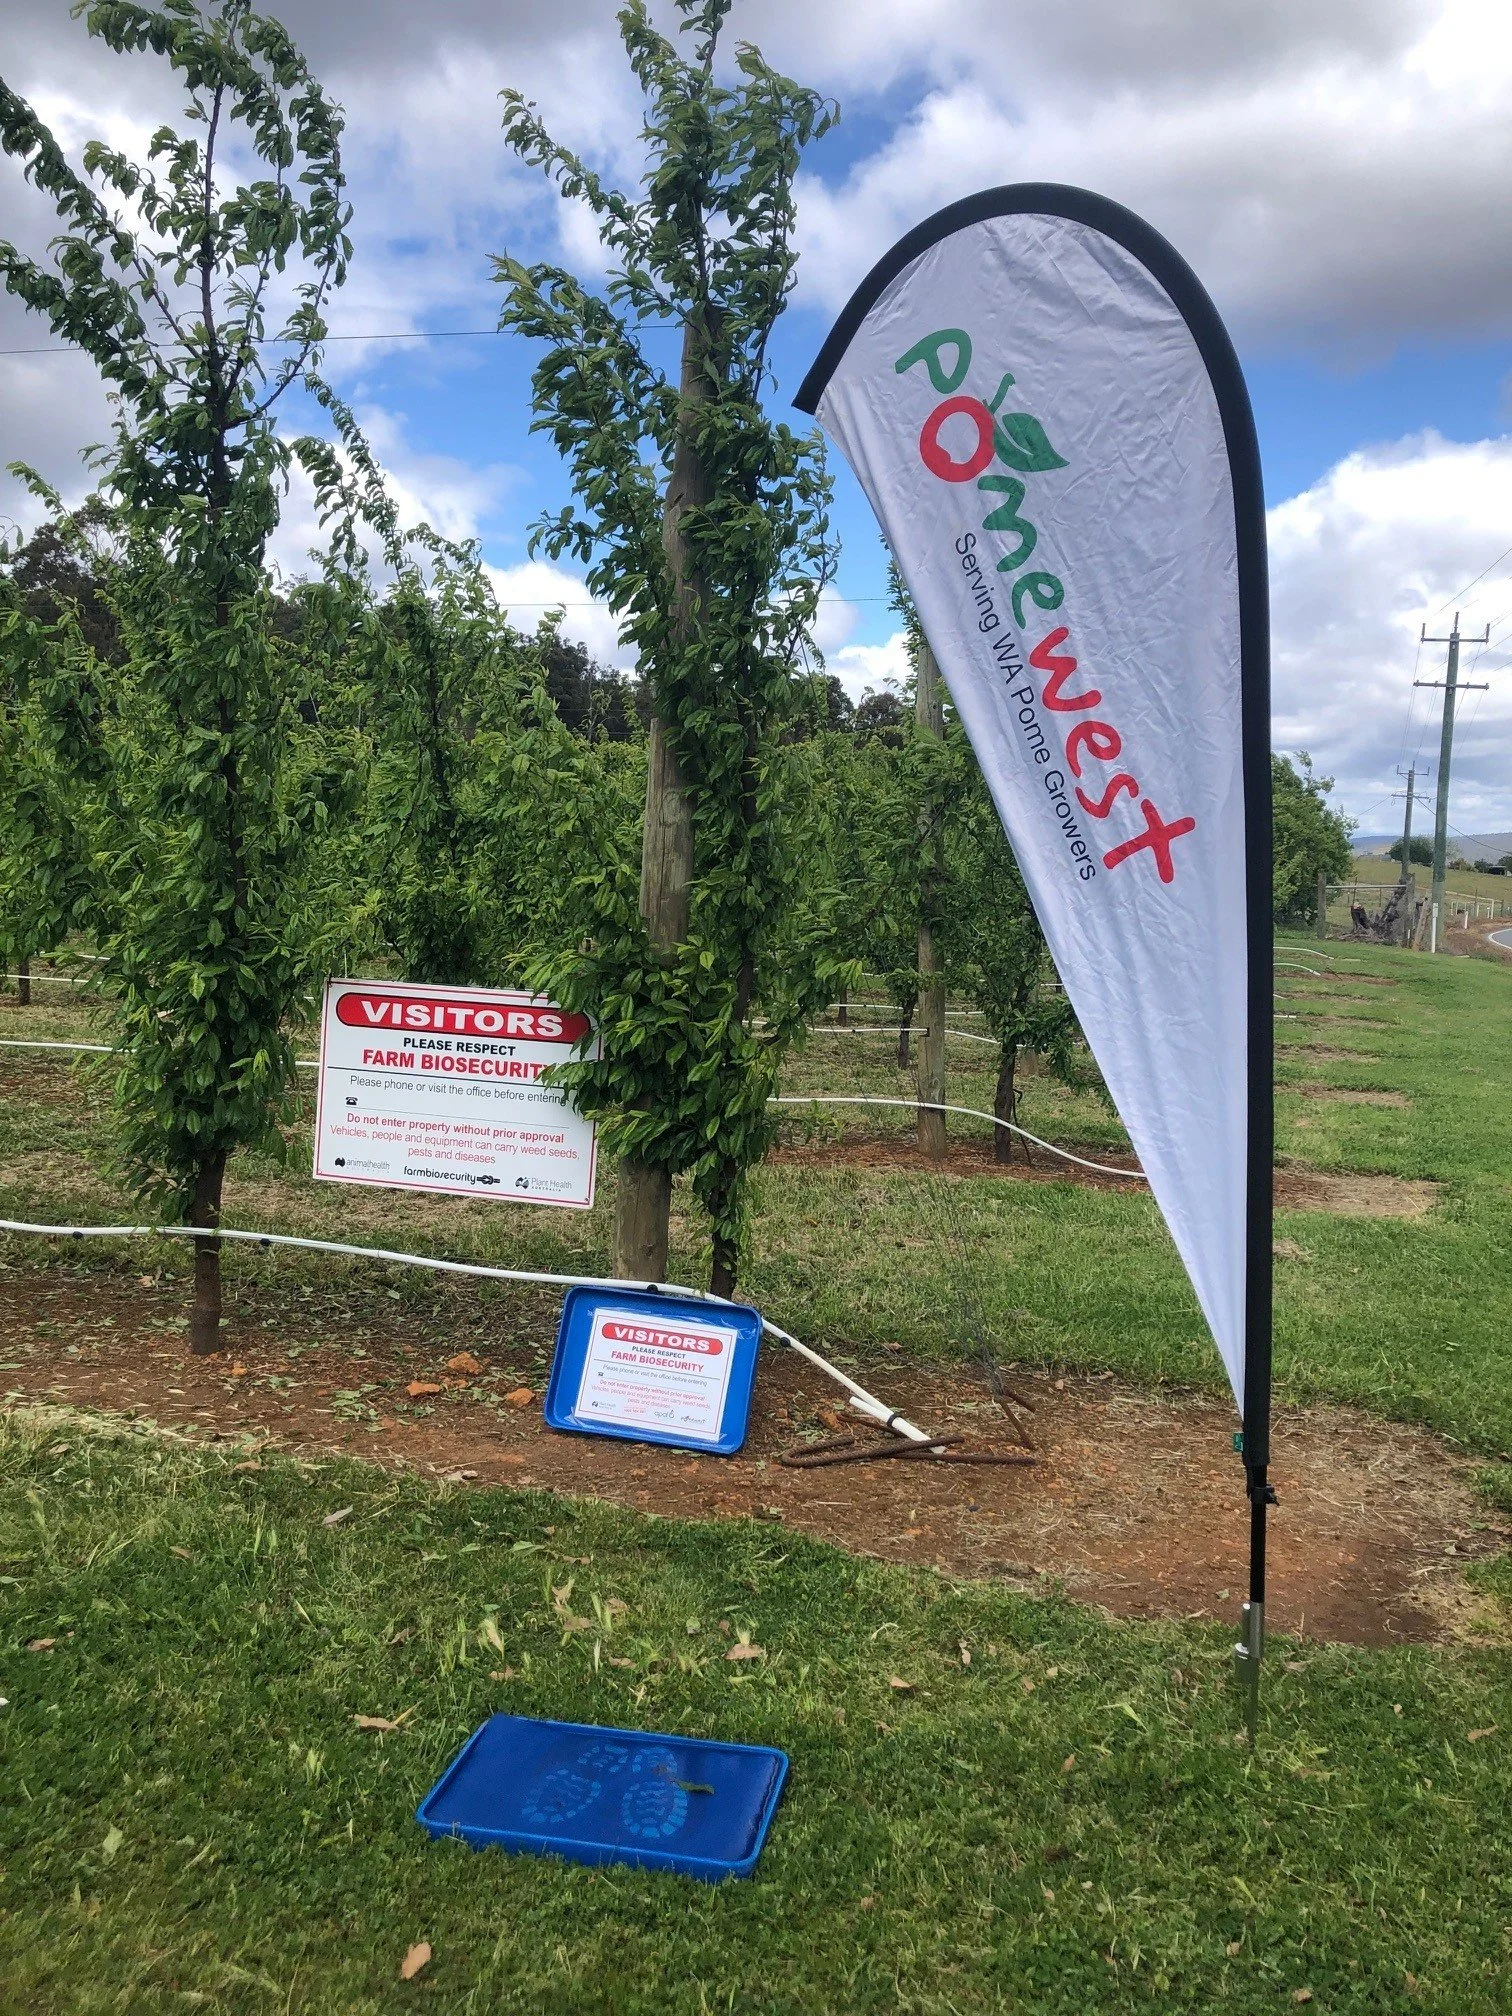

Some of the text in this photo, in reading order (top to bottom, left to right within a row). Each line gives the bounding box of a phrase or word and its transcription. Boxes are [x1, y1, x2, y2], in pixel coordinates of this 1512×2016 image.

[956, 532, 1096, 882] Serving WA Pome Growers
[361, 1001, 563, 1037] VISITORS
[403, 1037, 516, 1056] PLEASE RESPECT
[362, 1049, 549, 1079] FARM BIOSECURIT
[350, 1075, 381, 1087] Please
[384, 1079, 413, 1090] phone
[428, 1083, 446, 1093] visit
[448, 1085, 463, 1095] the
[466, 1086, 492, 1098] office
[494, 1089, 525, 1101] before
[347, 1112, 564, 1144] Do not enter property without prior approval
[330, 1125, 580, 1160] Vehicles, people and equipment can carry weed seeds,
[408, 1147, 496, 1164] pests and diseases
[404, 1166, 476, 1185] farmbiosecurity
[550, 1180, 573, 1189] Health
[613, 1326, 710, 1351] VISITORS
[611, 1351, 704, 1372] FARM BIOSECURITY
[632, 1346, 686, 1359] PLEASE RESPECT
